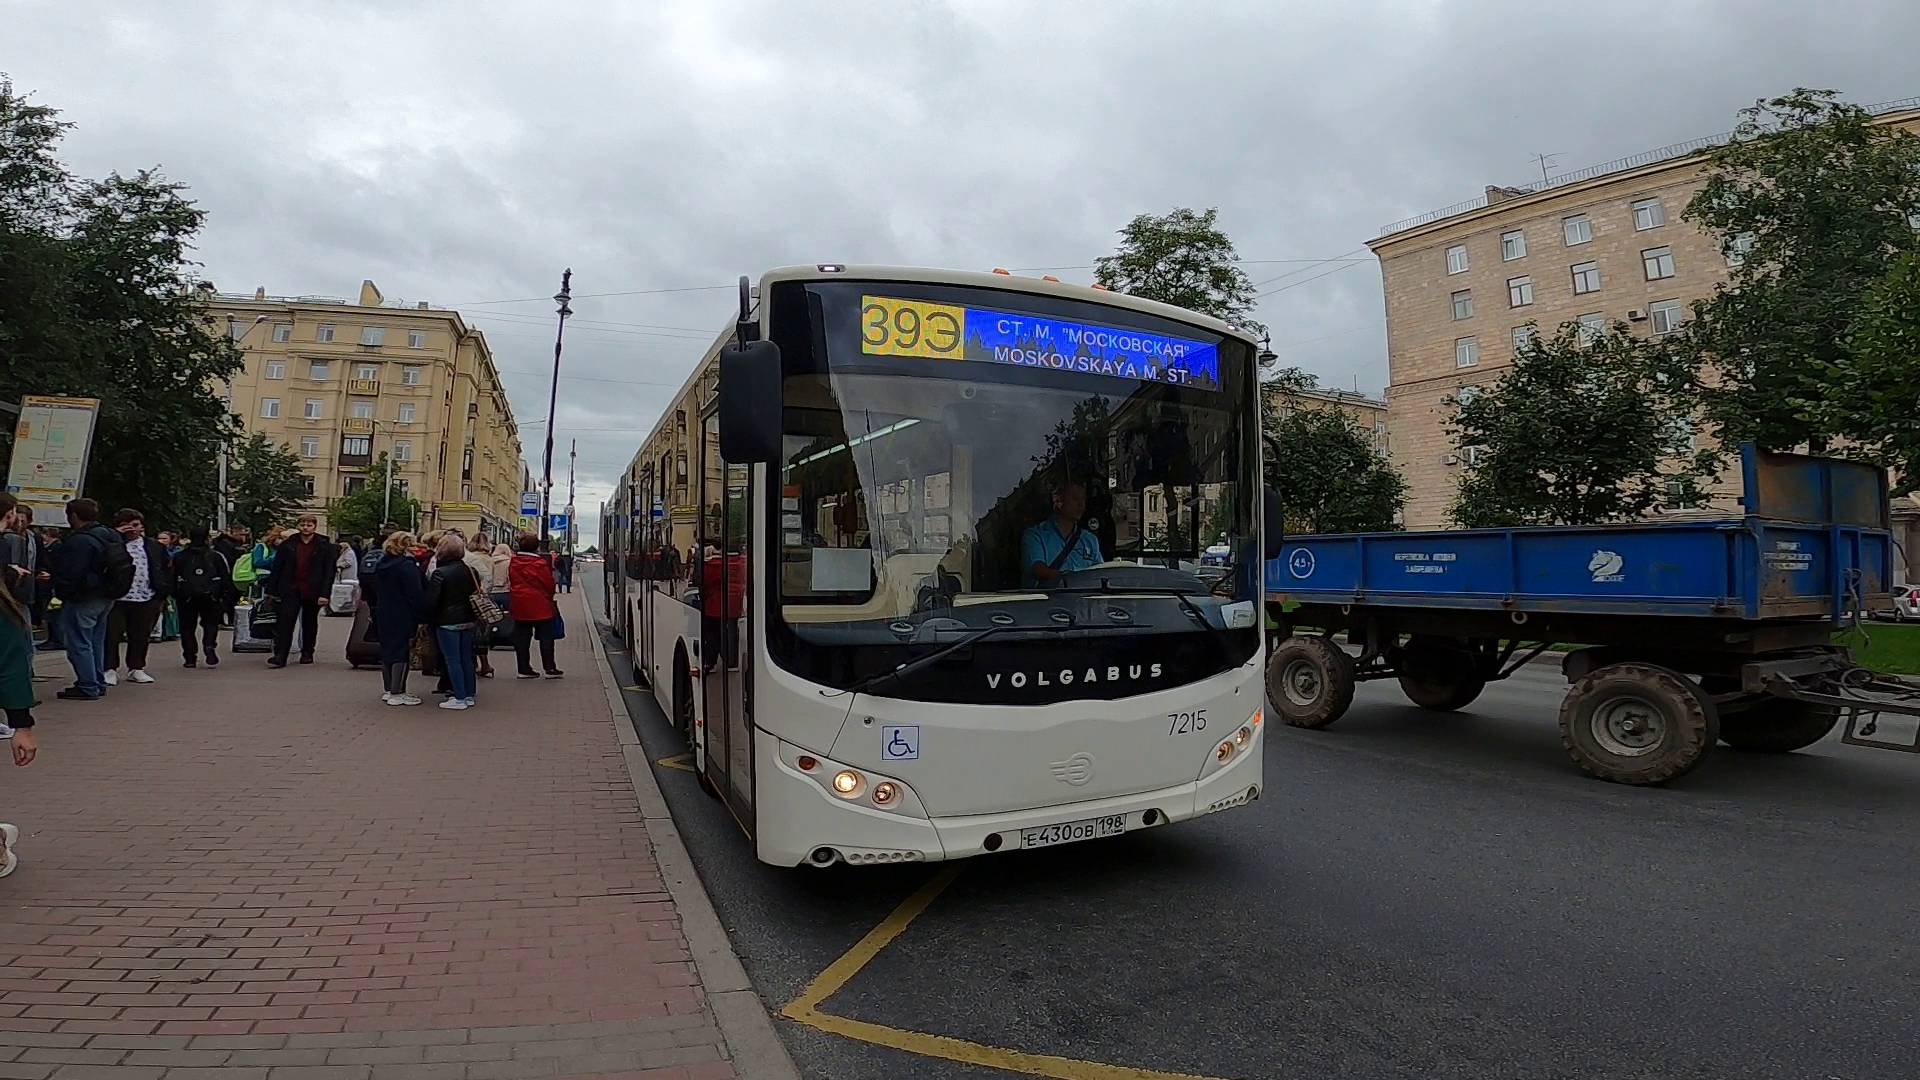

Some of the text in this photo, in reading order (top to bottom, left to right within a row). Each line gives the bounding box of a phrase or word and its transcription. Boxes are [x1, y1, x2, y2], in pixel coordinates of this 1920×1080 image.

[863, 303, 961, 353] 39Э
[997, 319, 1190, 359] СТ. М. "МОСКОВСКАЯ"
[994, 346, 1193, 384] MOSKOVSKAYA M. ST.
[986, 663, 1162, 689] VOLGABUS
[1168, 710, 1207, 735] 7215
[1099, 816, 1122, 829] 198
